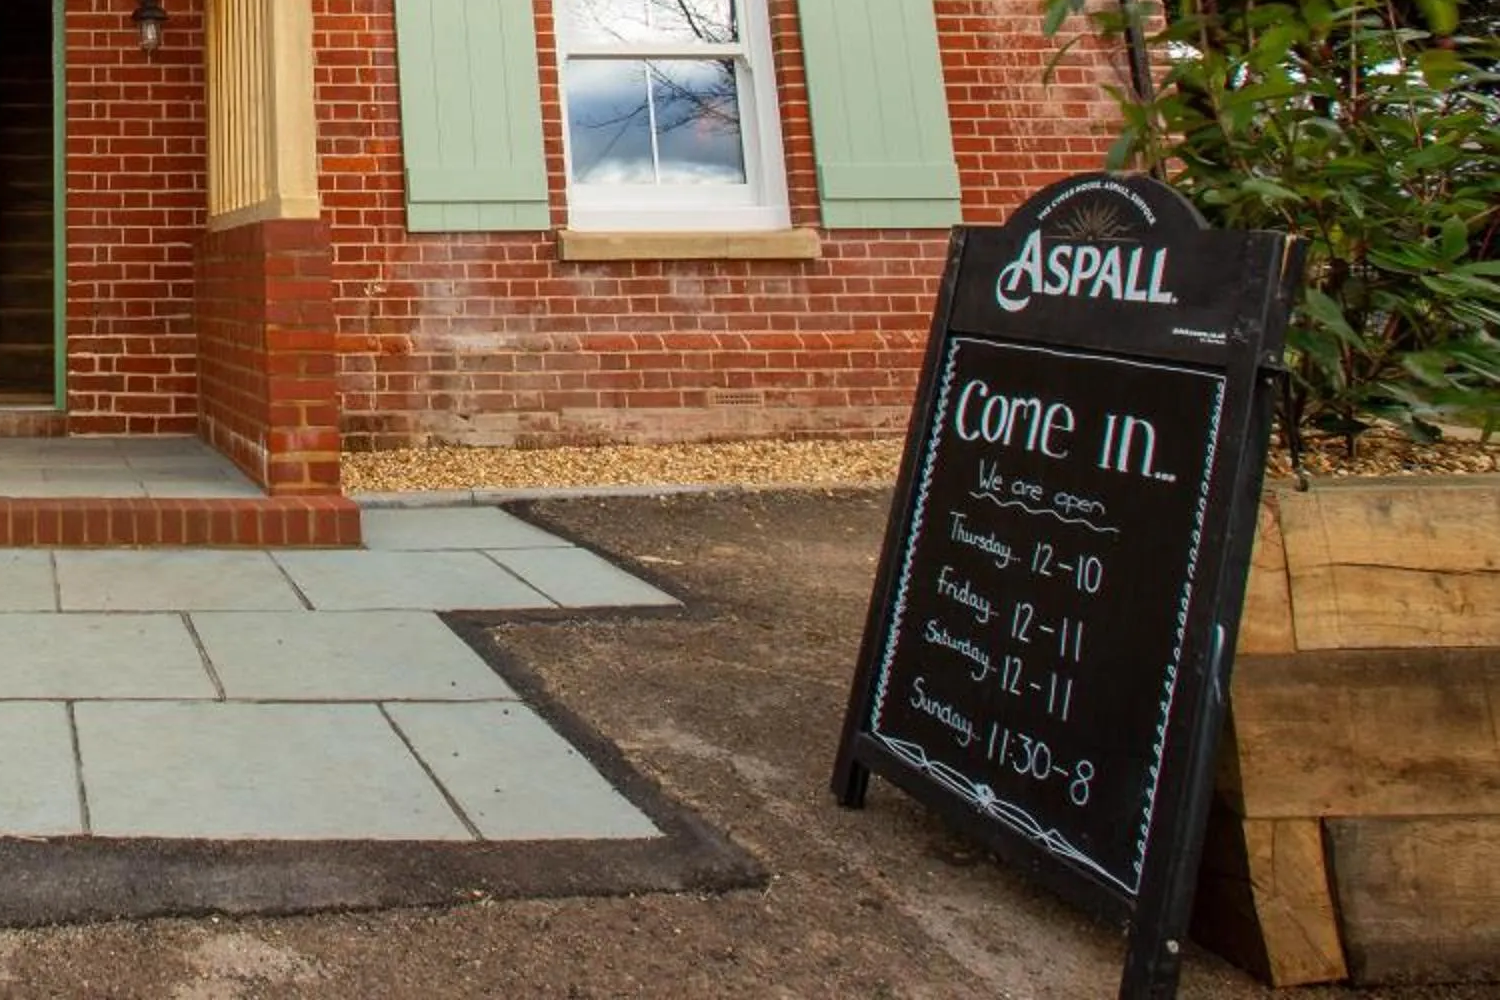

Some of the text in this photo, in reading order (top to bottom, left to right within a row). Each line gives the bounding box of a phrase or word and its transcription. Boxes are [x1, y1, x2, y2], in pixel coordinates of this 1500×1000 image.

[996, 228, 1173, 312] ASPALL
[955, 379, 1075, 459] Come
[979, 458, 1106, 516] We are open
